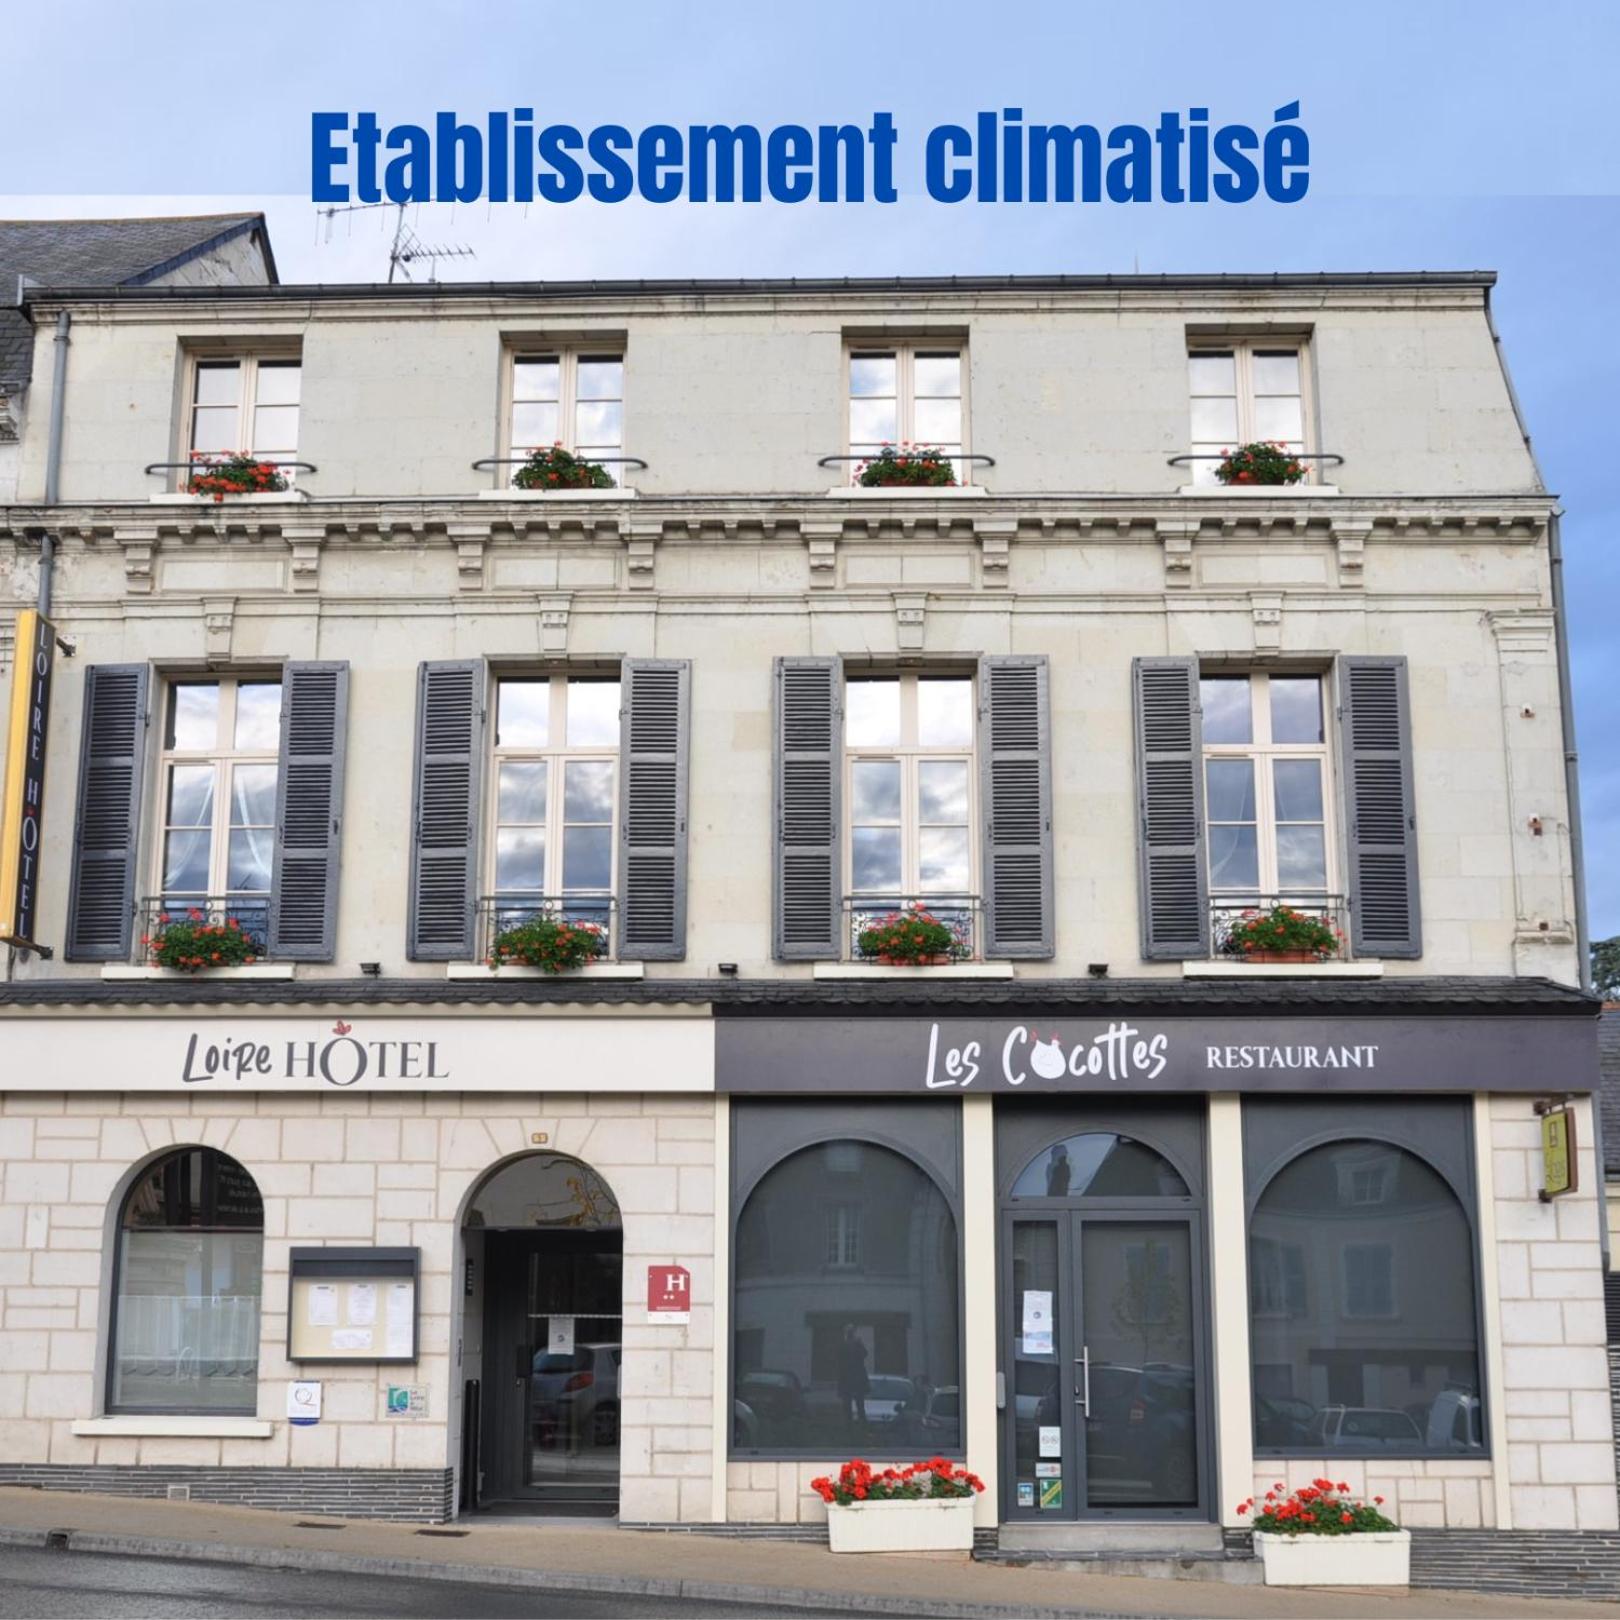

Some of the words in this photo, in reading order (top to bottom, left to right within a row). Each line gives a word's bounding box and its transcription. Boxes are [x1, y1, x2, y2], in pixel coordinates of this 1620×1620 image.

[31, 622, 49, 761] LOIRE
[926, 1023, 981, 1089] Les
[1206, 1045, 1379, 1068] RESTAURANT
[666, 1273, 685, 1291] H
